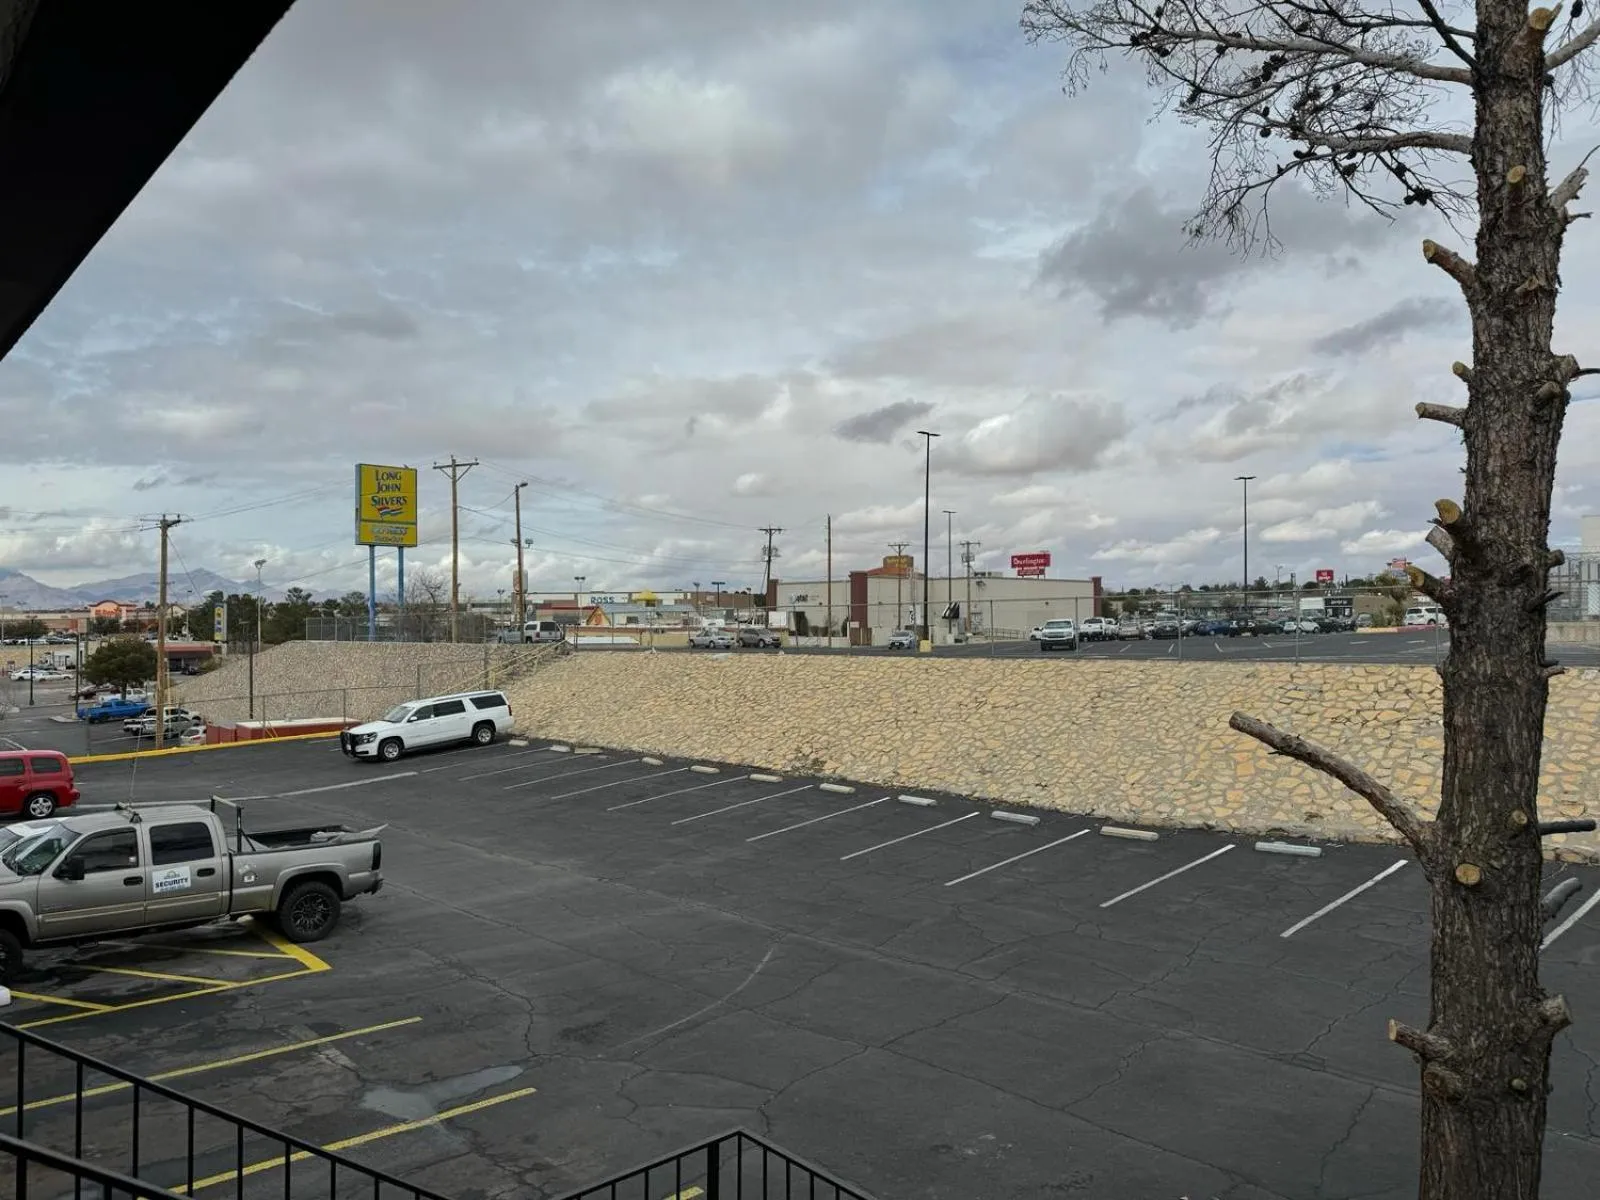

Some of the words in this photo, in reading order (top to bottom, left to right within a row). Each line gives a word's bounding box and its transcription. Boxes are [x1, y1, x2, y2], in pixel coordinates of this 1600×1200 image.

[375, 469, 402, 482] LONG
[376, 482, 401, 494] JOHN
[591, 596, 616, 605] ROSS
[155, 878, 188, 888] SECURITY
